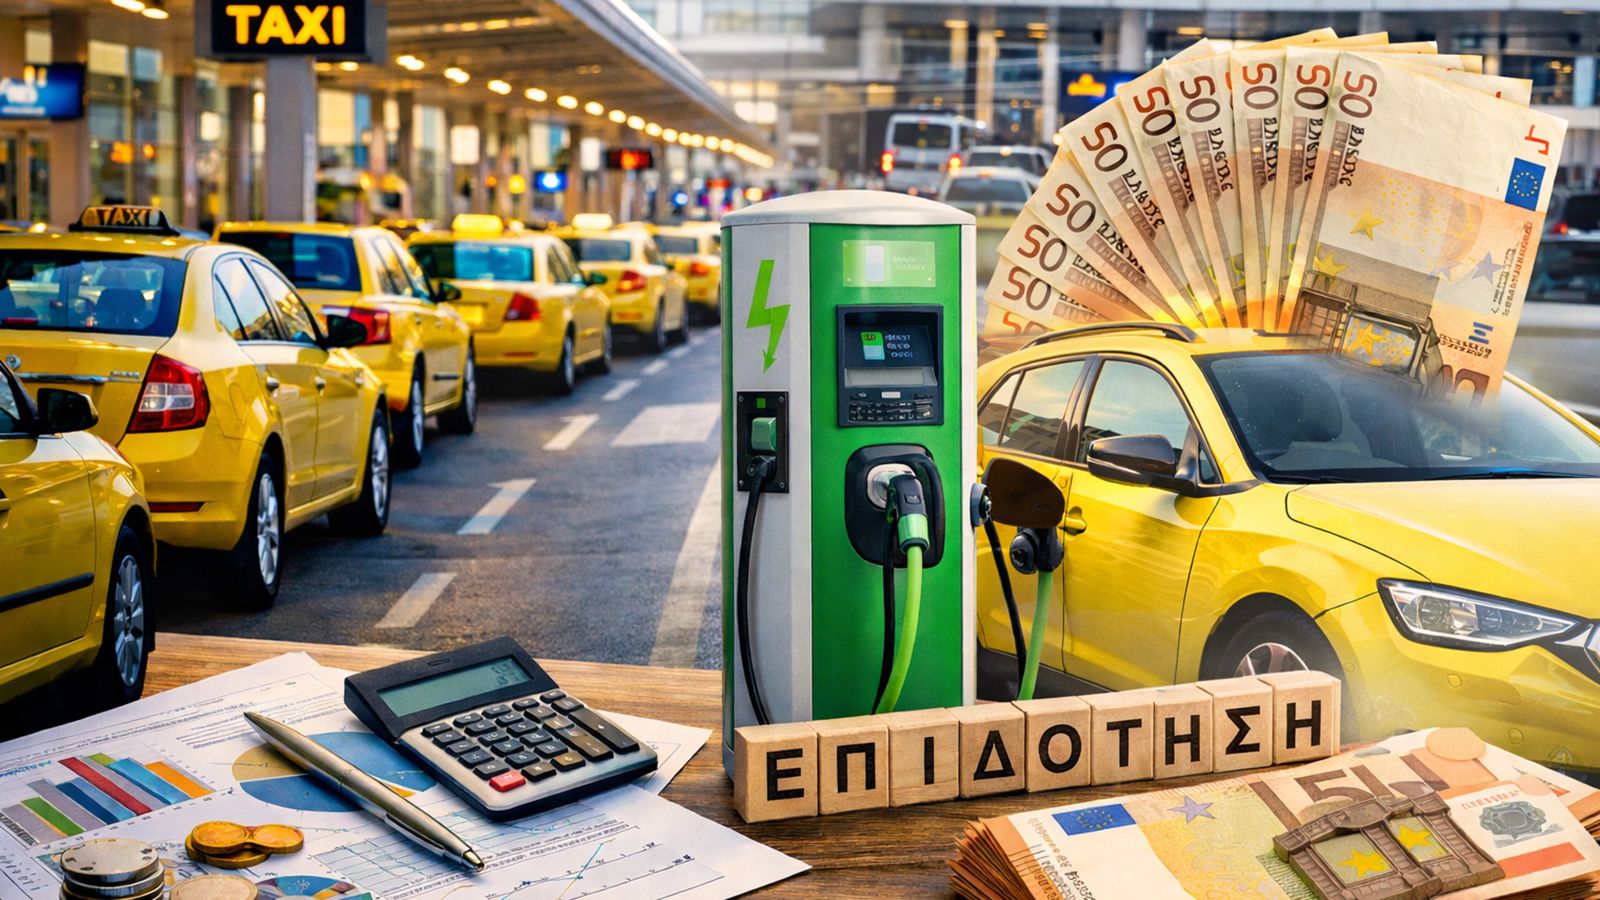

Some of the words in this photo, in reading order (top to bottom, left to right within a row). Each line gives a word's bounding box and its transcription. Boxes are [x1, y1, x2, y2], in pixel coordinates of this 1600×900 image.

[225, 5, 346, 45] TAXI
[96, 207, 150, 226] TAXI
[767, 699, 1322, 802] ΕΠΙΔΟΤΗΣΗ
